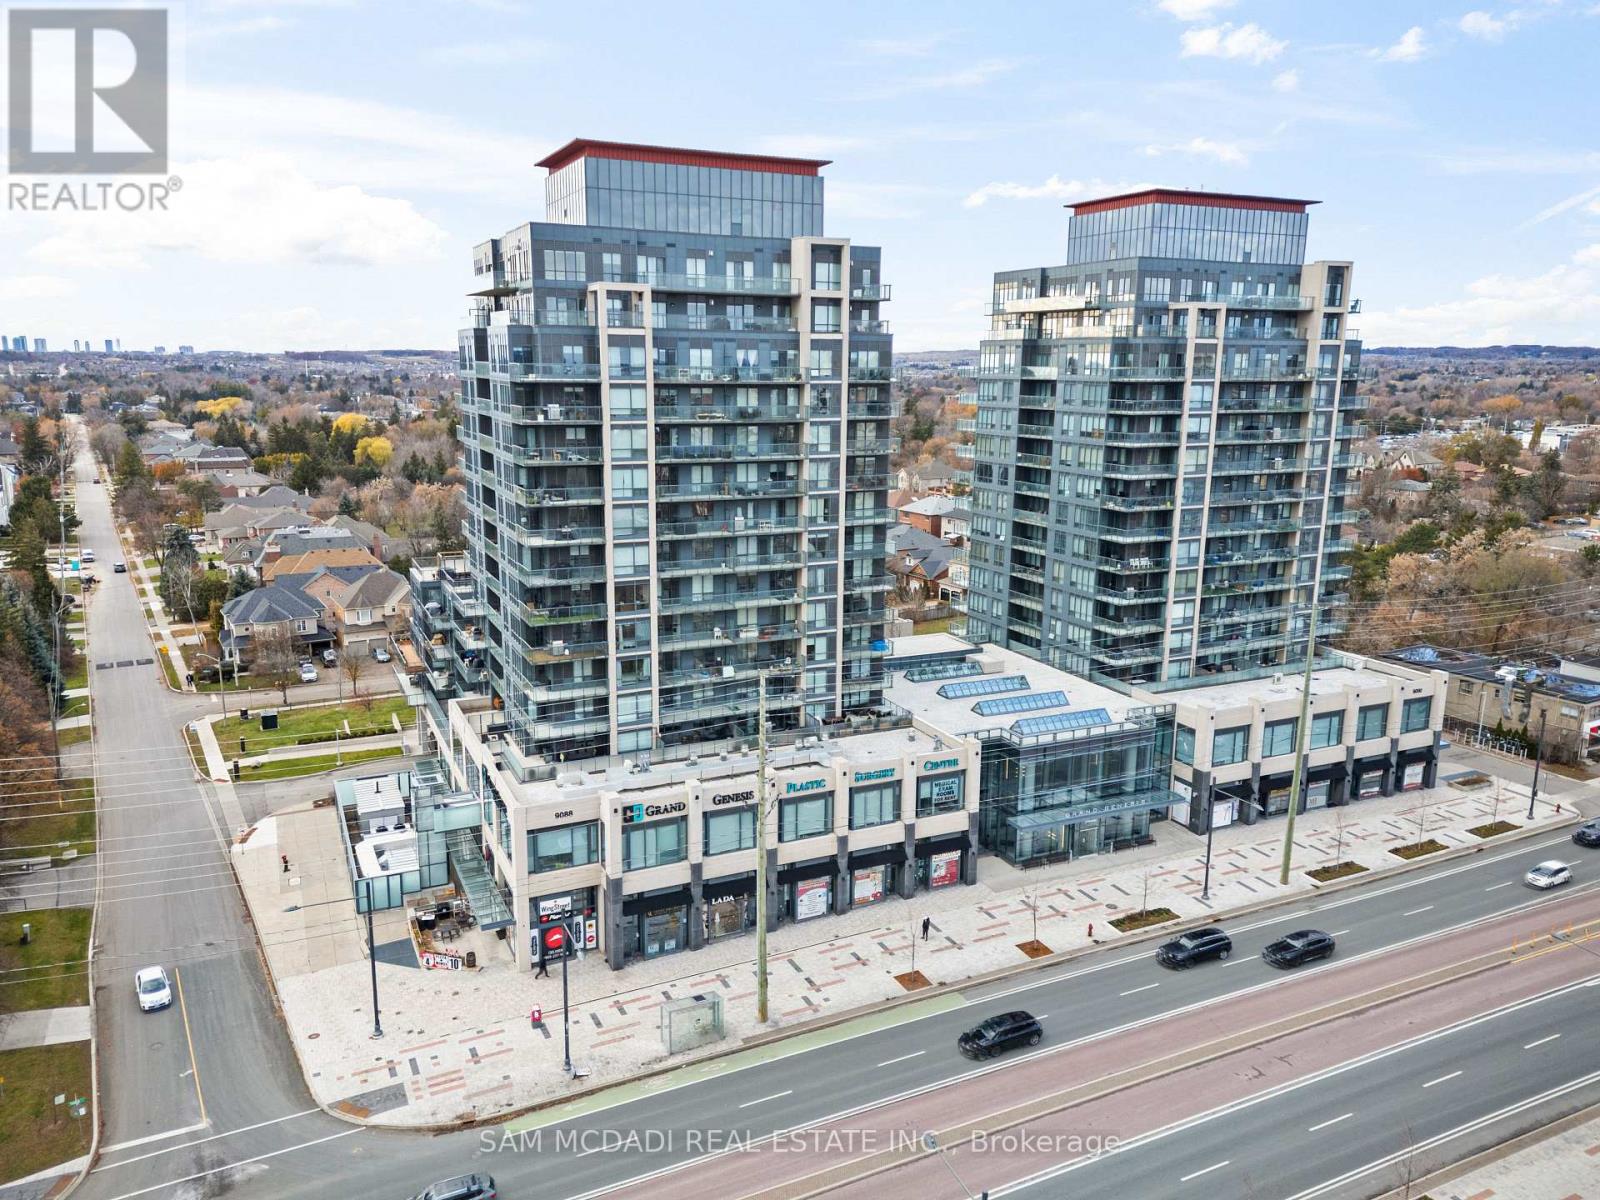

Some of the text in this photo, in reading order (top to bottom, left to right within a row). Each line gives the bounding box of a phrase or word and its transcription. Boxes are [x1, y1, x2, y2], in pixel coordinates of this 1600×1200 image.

[645, 758, 959, 817] GRAND GENESIS PLASTIC SURGERY CENTRE
[711, 895, 735, 905] LADA
[541, 902, 570, 913] WingStreet
